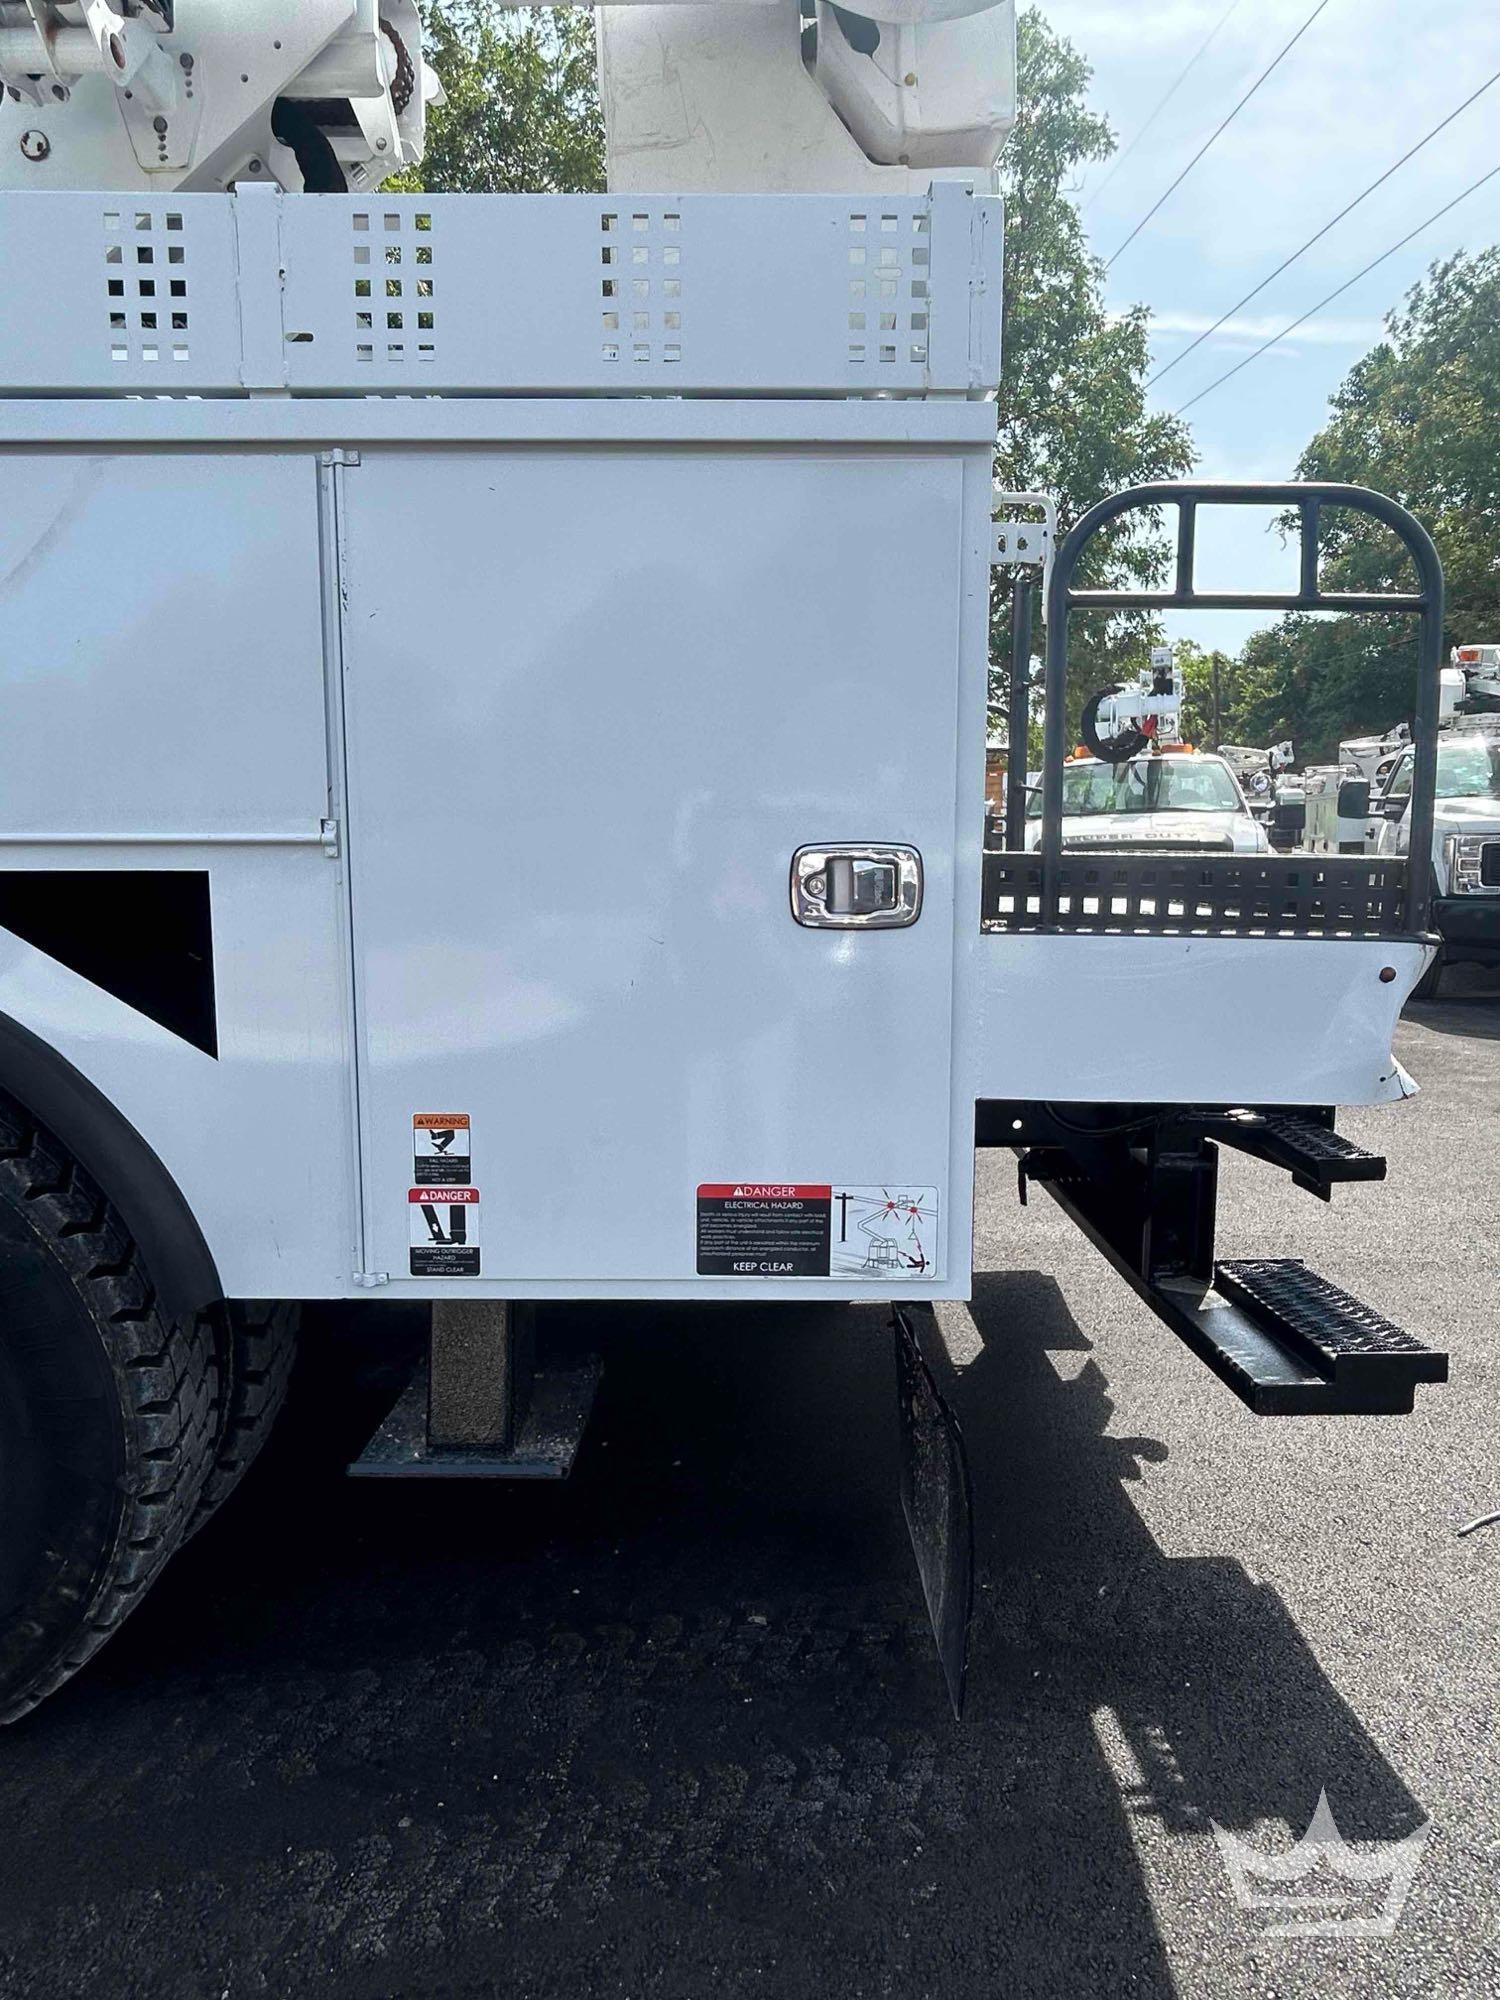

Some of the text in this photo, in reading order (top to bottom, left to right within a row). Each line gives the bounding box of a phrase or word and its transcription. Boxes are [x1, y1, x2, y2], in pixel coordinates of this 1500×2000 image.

[425, 1117, 467, 1125] WARNING
[429, 1191, 471, 1200] DANGER
[744, 1186, 796, 1197] DANGER
[724, 1201, 769, 1209] ELECTRICAL
[733, 1262, 794, 1272] KEEP CLEAR
